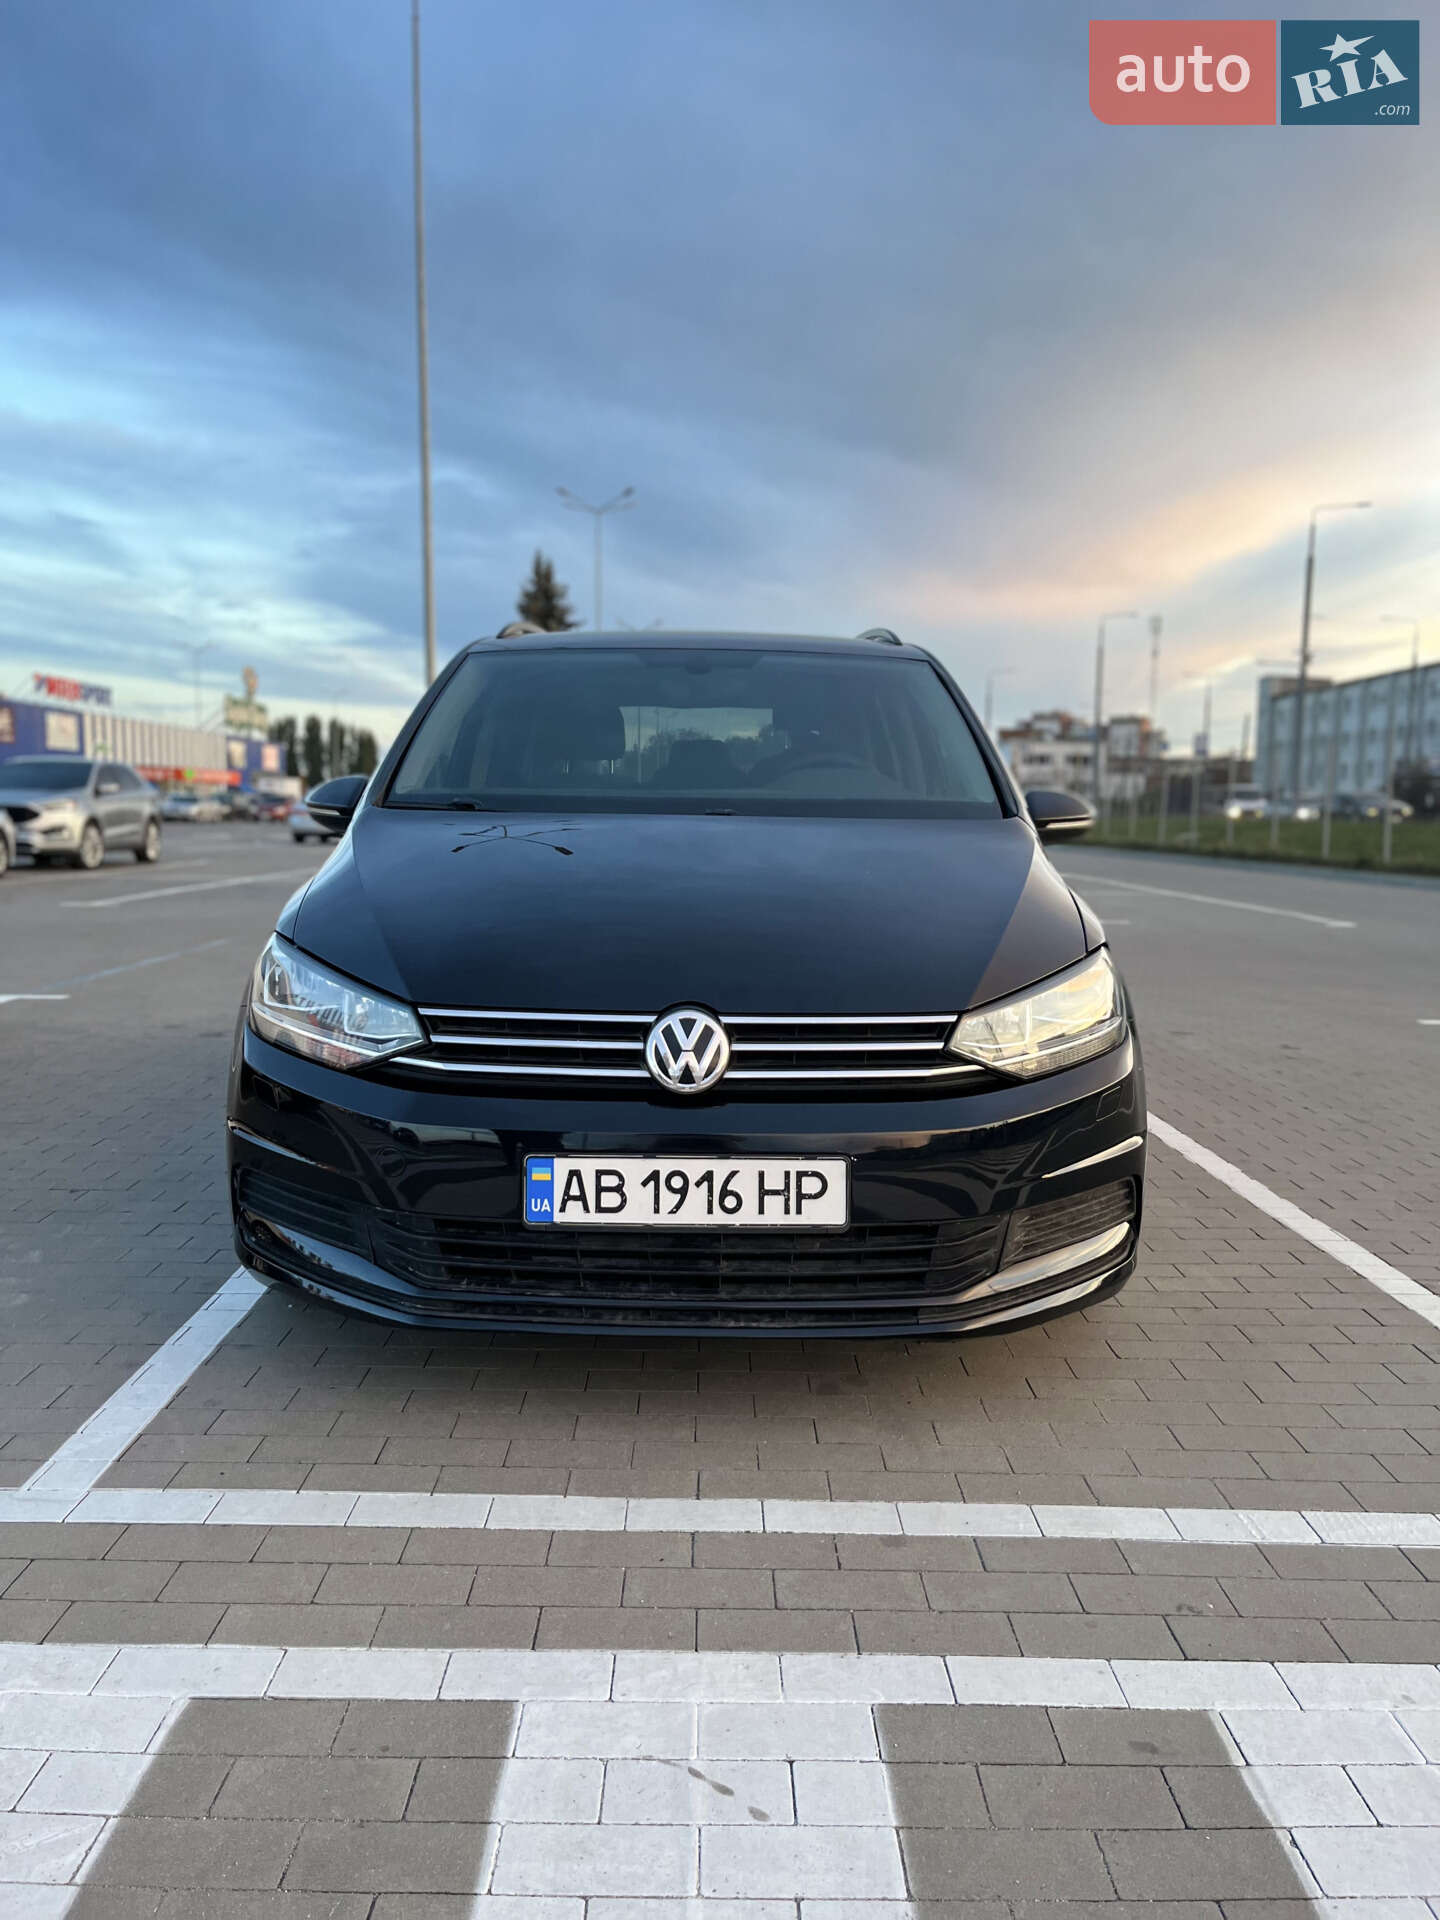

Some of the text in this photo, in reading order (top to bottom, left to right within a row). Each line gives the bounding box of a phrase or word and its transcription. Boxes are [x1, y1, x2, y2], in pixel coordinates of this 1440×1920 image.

[530, 1197, 551, 1212] UA
[558, 1168, 829, 1216] AB 1916 HP
